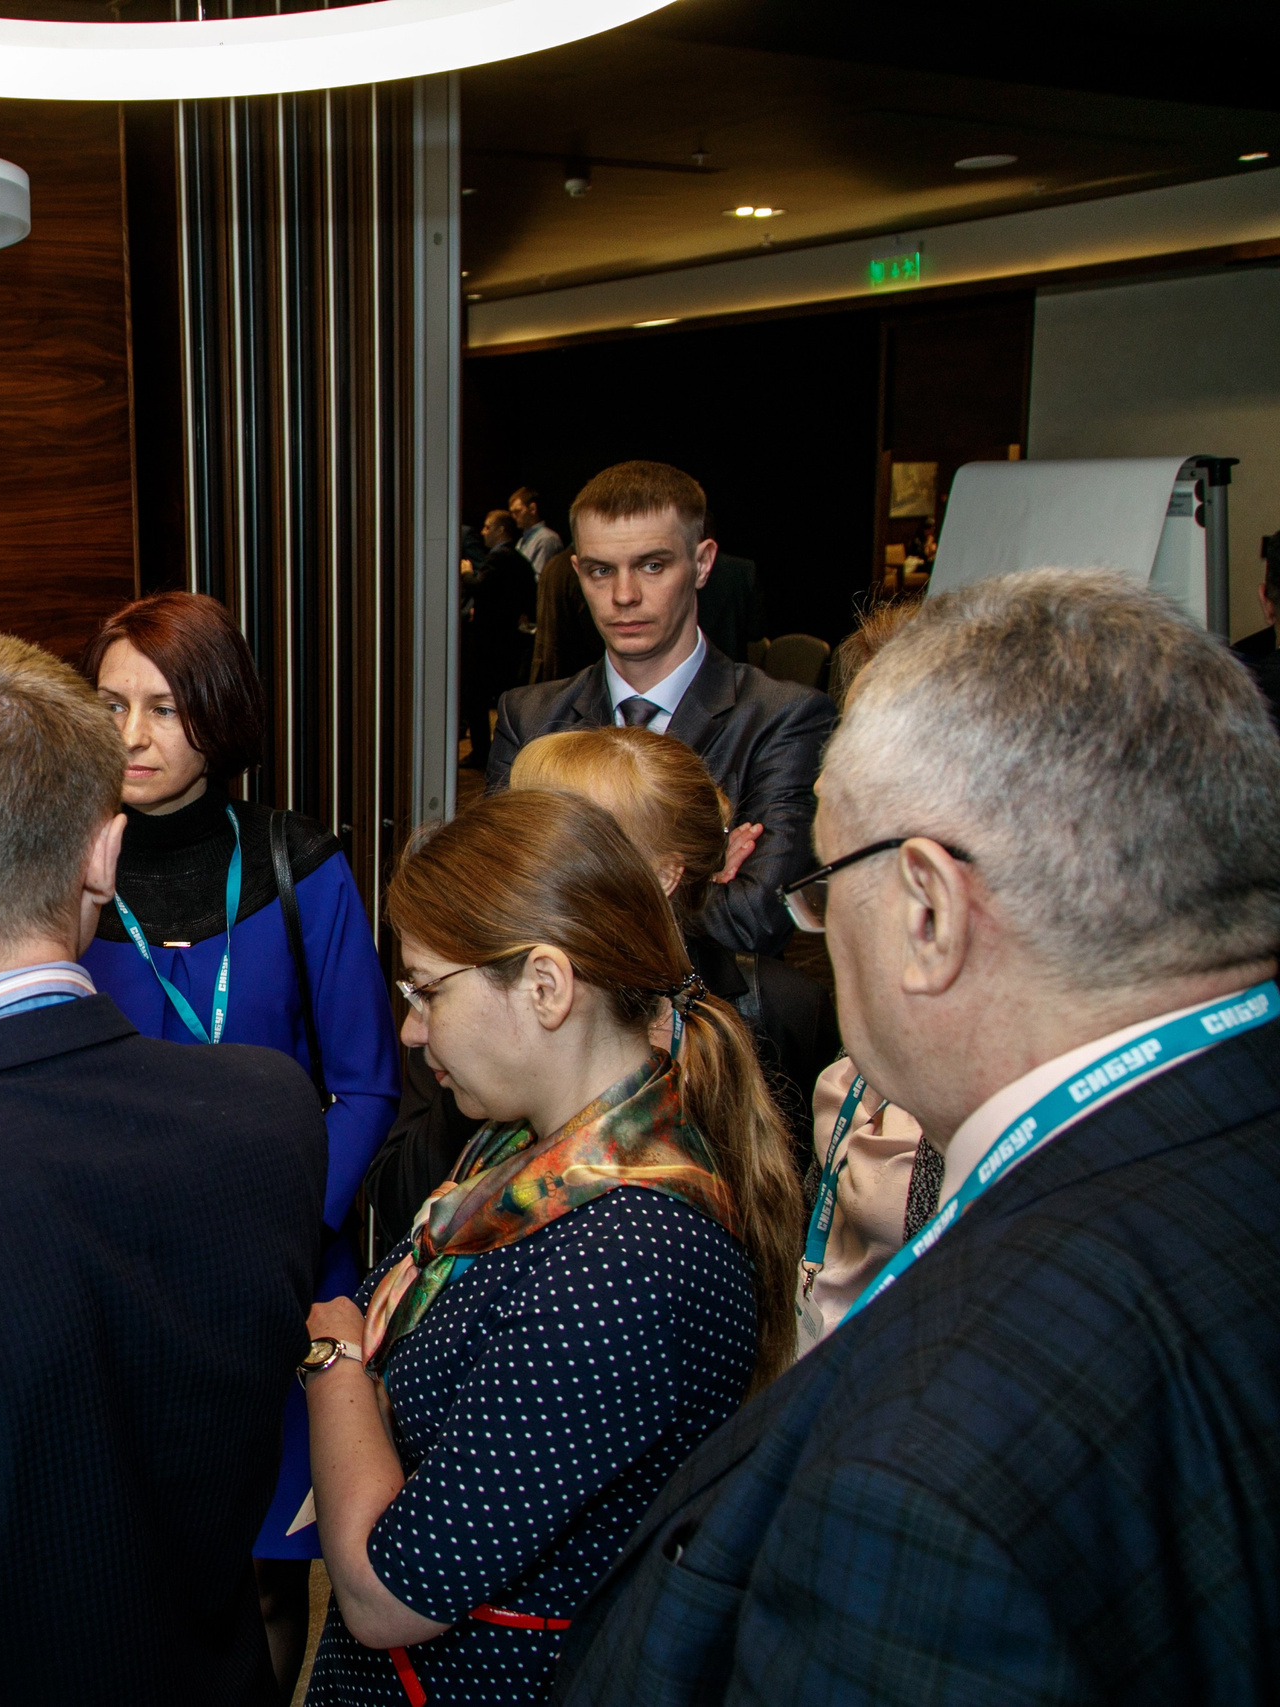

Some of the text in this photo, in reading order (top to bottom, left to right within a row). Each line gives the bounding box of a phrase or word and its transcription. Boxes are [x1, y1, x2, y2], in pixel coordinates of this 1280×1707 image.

[129, 926, 149, 960] СИБУР
[218, 954, 228, 992] СИБУР
[1201, 991, 1271, 1036] СИБУР
[1067, 1038, 1163, 1104] СИБУР
[977, 1116, 1038, 1185] СИБУР
[817, 1189, 834, 1233] СИБУР
